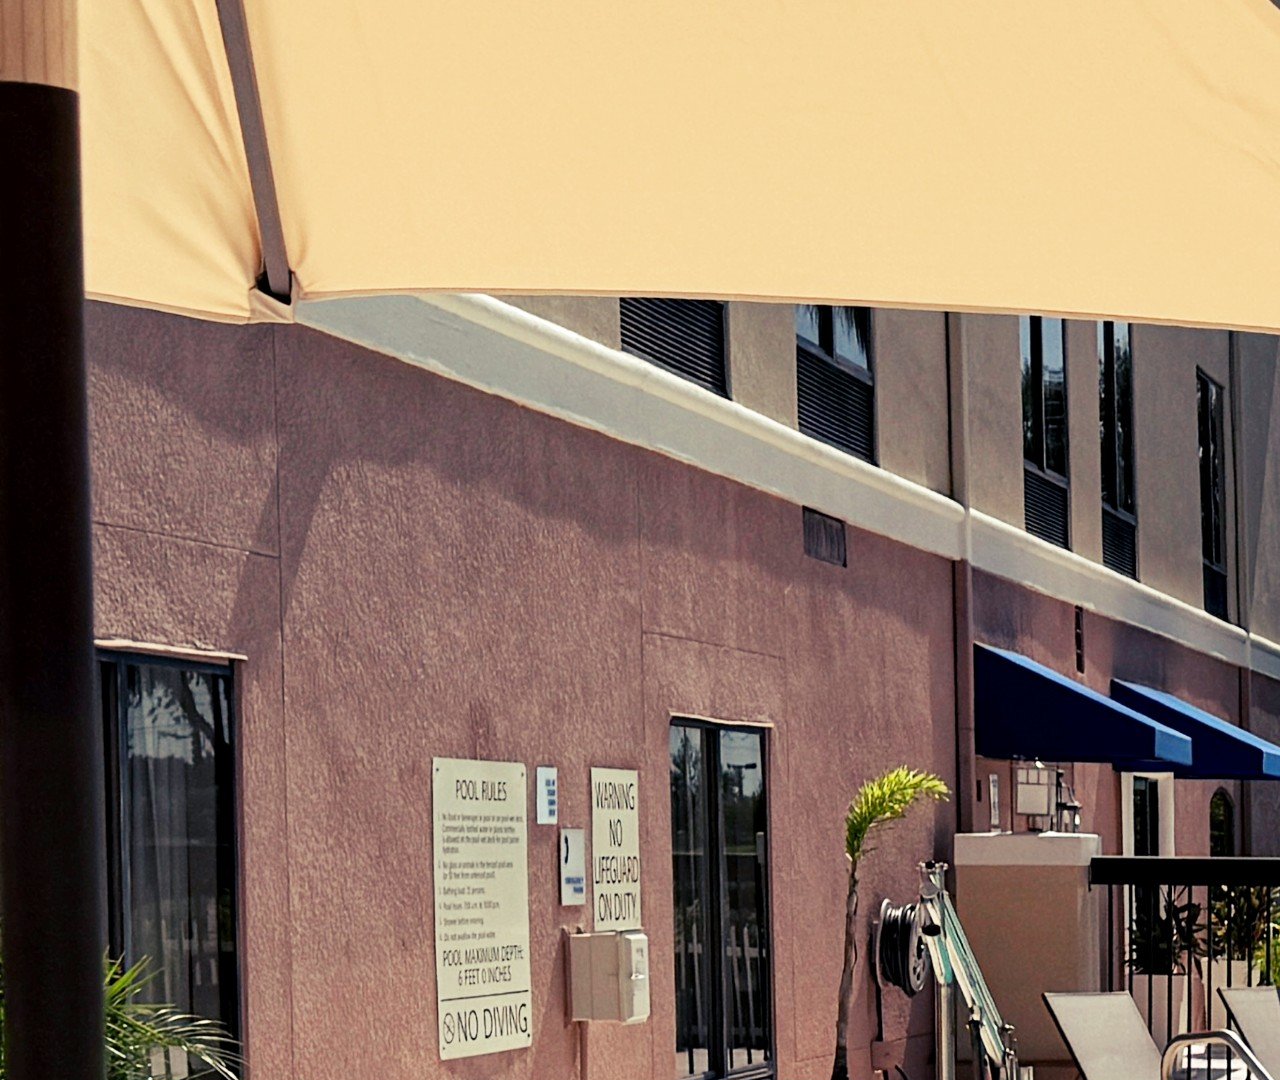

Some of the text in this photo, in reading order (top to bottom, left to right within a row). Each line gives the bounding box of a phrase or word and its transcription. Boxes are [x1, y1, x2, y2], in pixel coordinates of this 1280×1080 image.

[456, 780, 507, 801] POOL RULES
[595, 782, 635, 810] WARNING
[609, 819, 623, 847] NO
[594, 856, 639, 884] LIFEGUARD
[599, 893, 637, 921] ON DUTY
[442, 949, 462, 966] POOL
[464, 968, 479, 985] FEET
[488, 965, 512, 983] INCHES
[457, 1003, 528, 1042] NO DIVING
